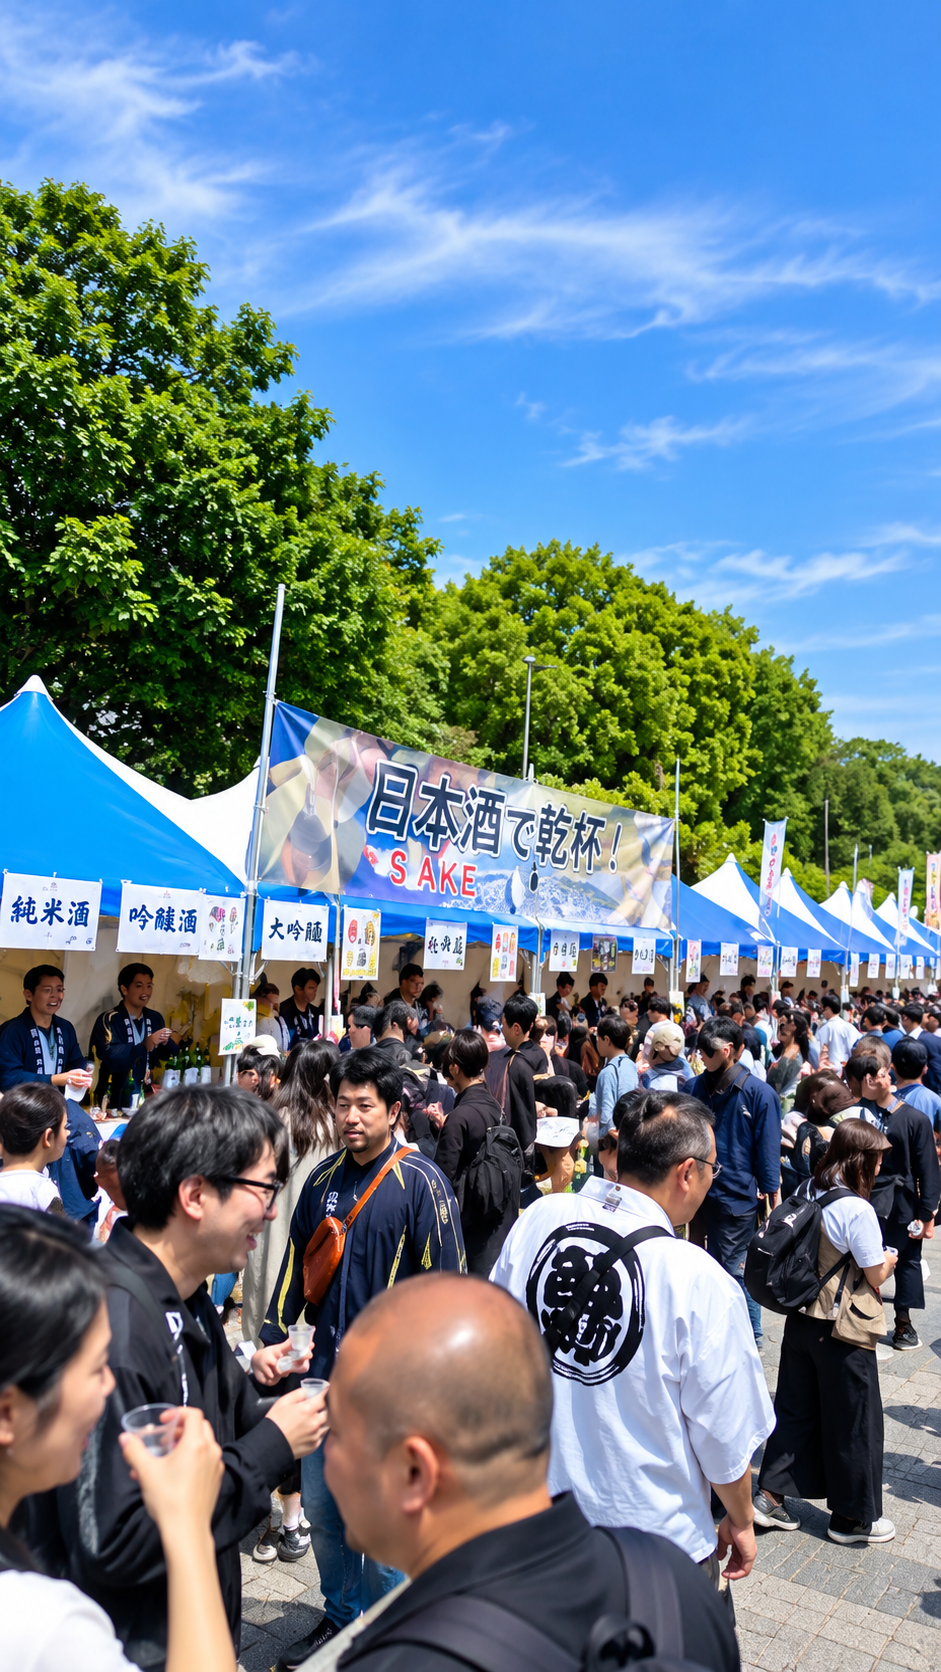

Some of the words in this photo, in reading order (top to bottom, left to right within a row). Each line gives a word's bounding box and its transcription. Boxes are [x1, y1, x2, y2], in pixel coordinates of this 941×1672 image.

[367, 759, 622, 874] 日本酒で乾杯！
[390, 848, 477, 898] SAKE
[10, 895, 90, 927] 純米酒
